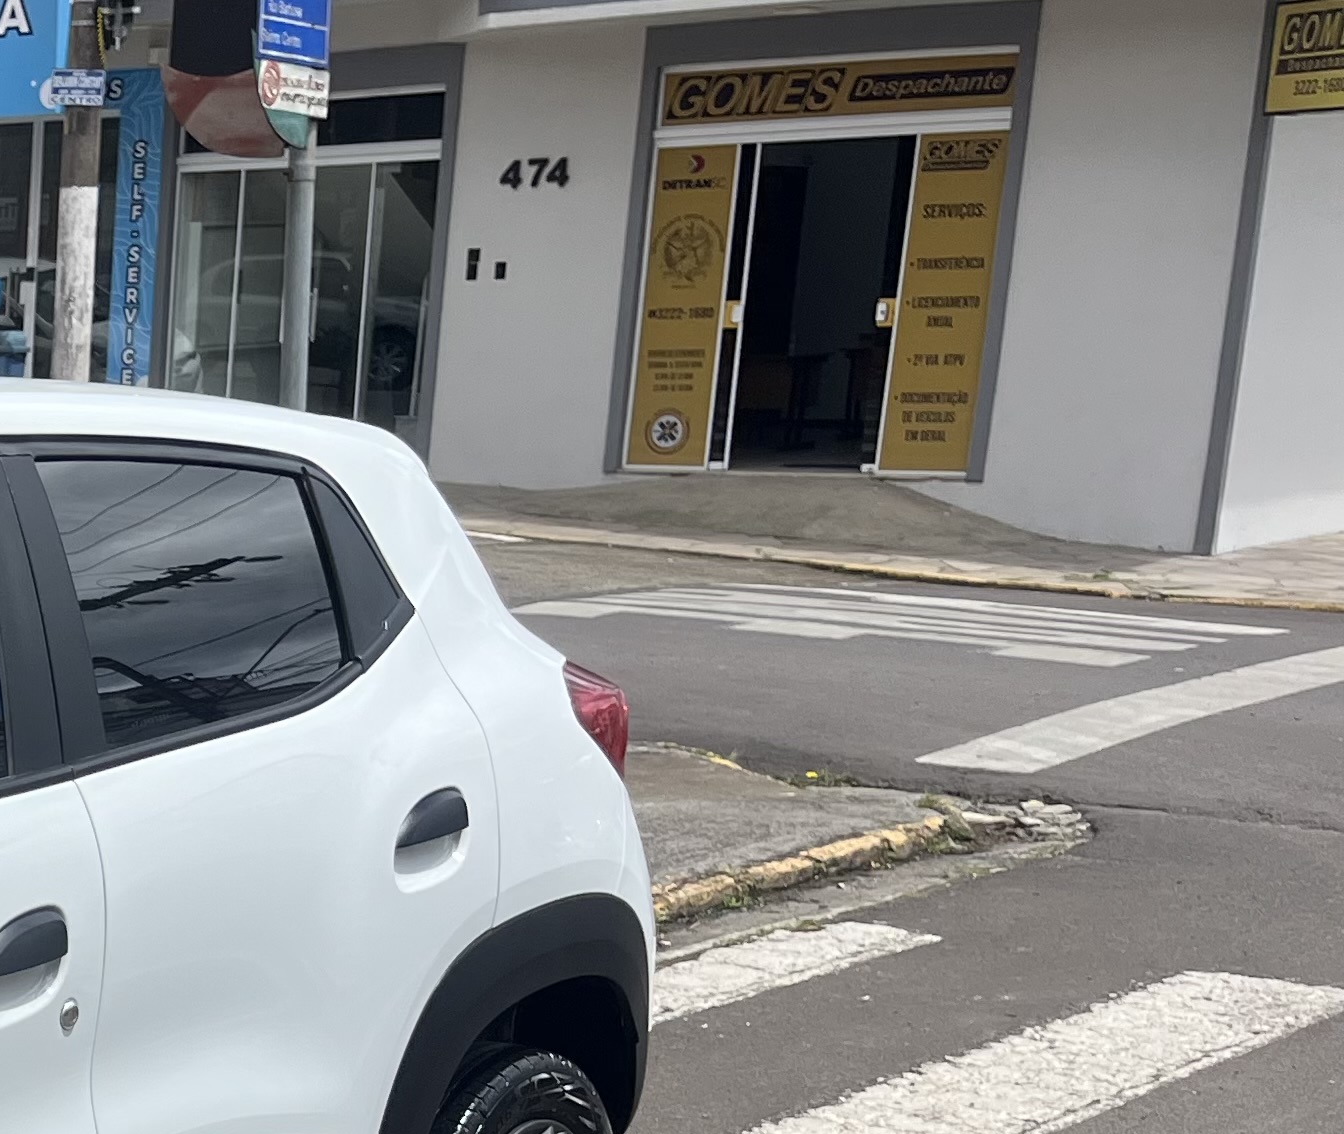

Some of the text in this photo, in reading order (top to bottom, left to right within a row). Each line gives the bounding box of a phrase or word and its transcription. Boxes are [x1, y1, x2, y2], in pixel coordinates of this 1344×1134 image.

[1284, 11, 1344, 50] GOM
[669, 68, 1008, 118] GOMES Despachante
[499, 156, 570, 190] 474
